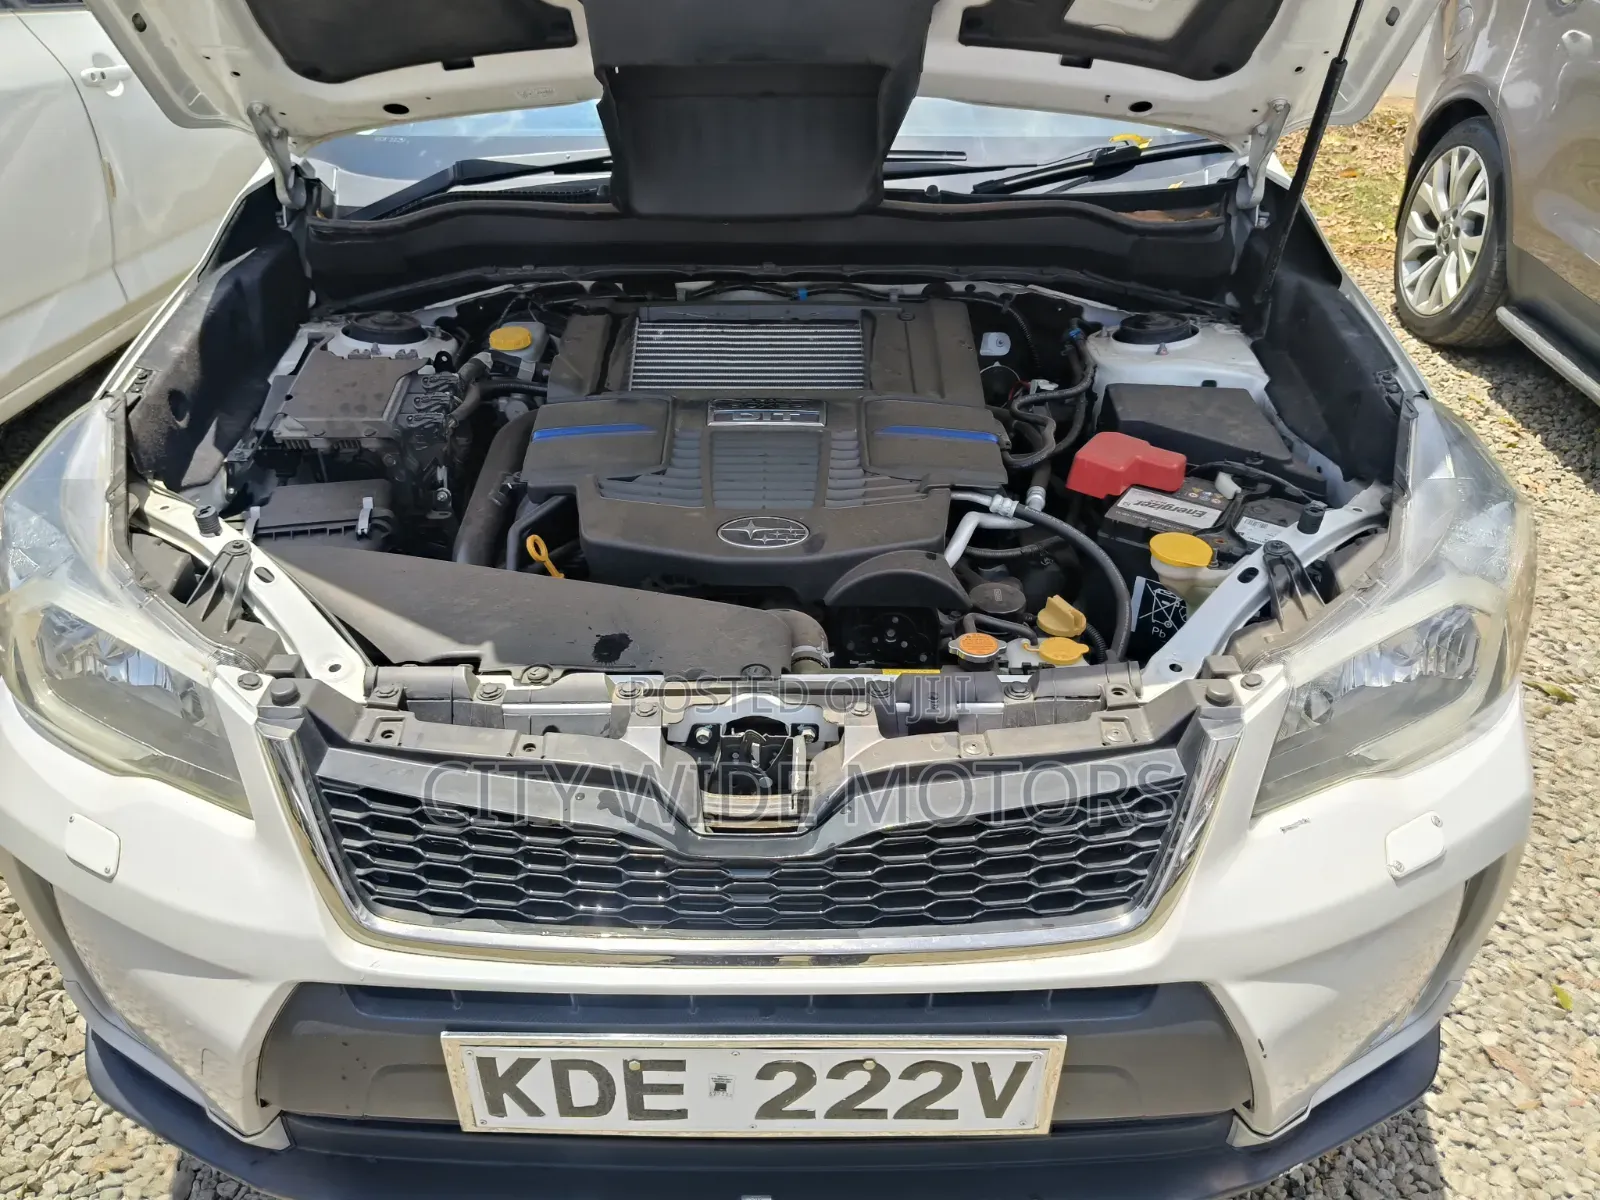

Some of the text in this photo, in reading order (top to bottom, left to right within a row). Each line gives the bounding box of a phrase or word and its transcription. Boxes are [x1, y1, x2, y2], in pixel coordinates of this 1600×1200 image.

[1132, 499, 1207, 519] Energizer
[1151, 626, 1166, 639] Pb
[476, 1055, 1035, 1121] KDE 222V
